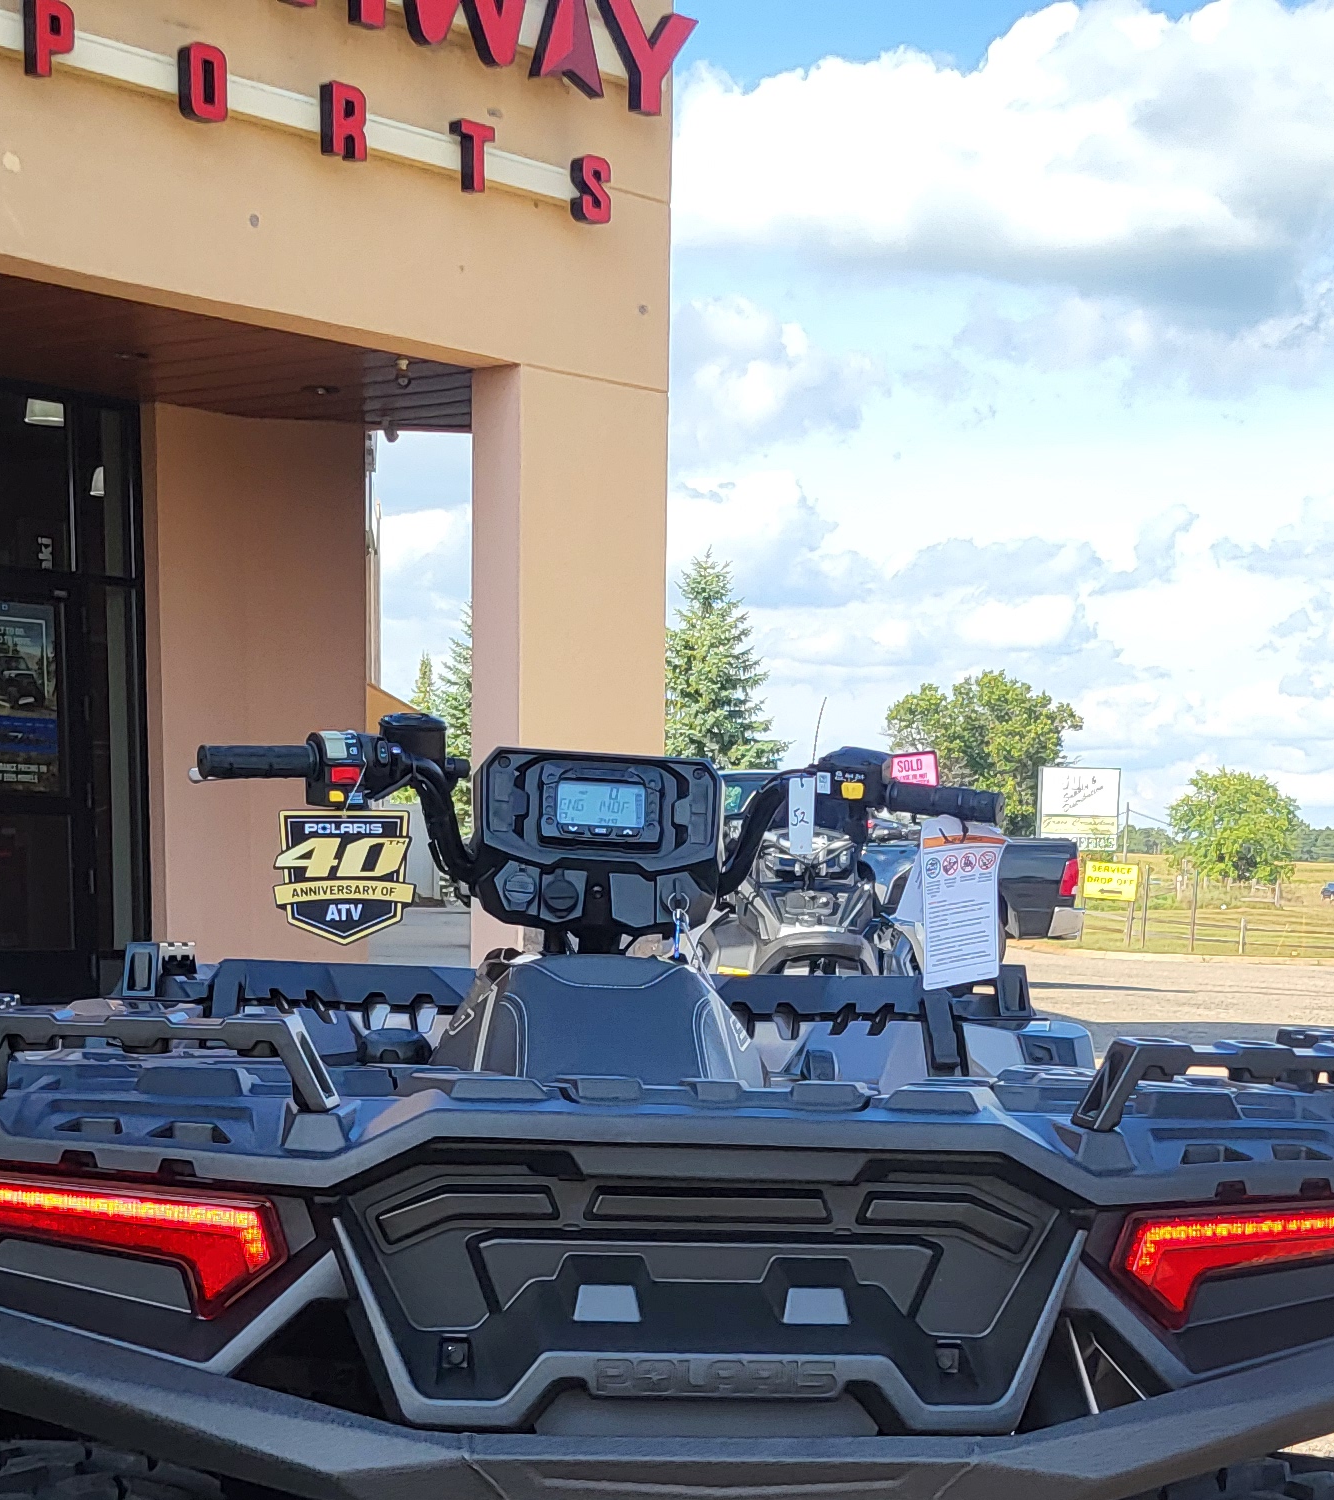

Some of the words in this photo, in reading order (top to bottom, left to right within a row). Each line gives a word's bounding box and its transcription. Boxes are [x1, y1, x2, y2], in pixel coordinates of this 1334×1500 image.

[897, 758, 923, 773] SOLD
[558, 798, 585, 812] ENG
[790, 807, 809, 827] 52
[304, 823, 383, 834] POLARIS
[1091, 864, 1133, 875] SERVICE
[1086, 875, 1113, 885] DROP
[291, 885, 378, 899] ANNIVERSARY
[380, 886, 397, 897] OF
[325, 904, 363, 921] ATV
[596, 1358, 838, 1397] POLARIS
